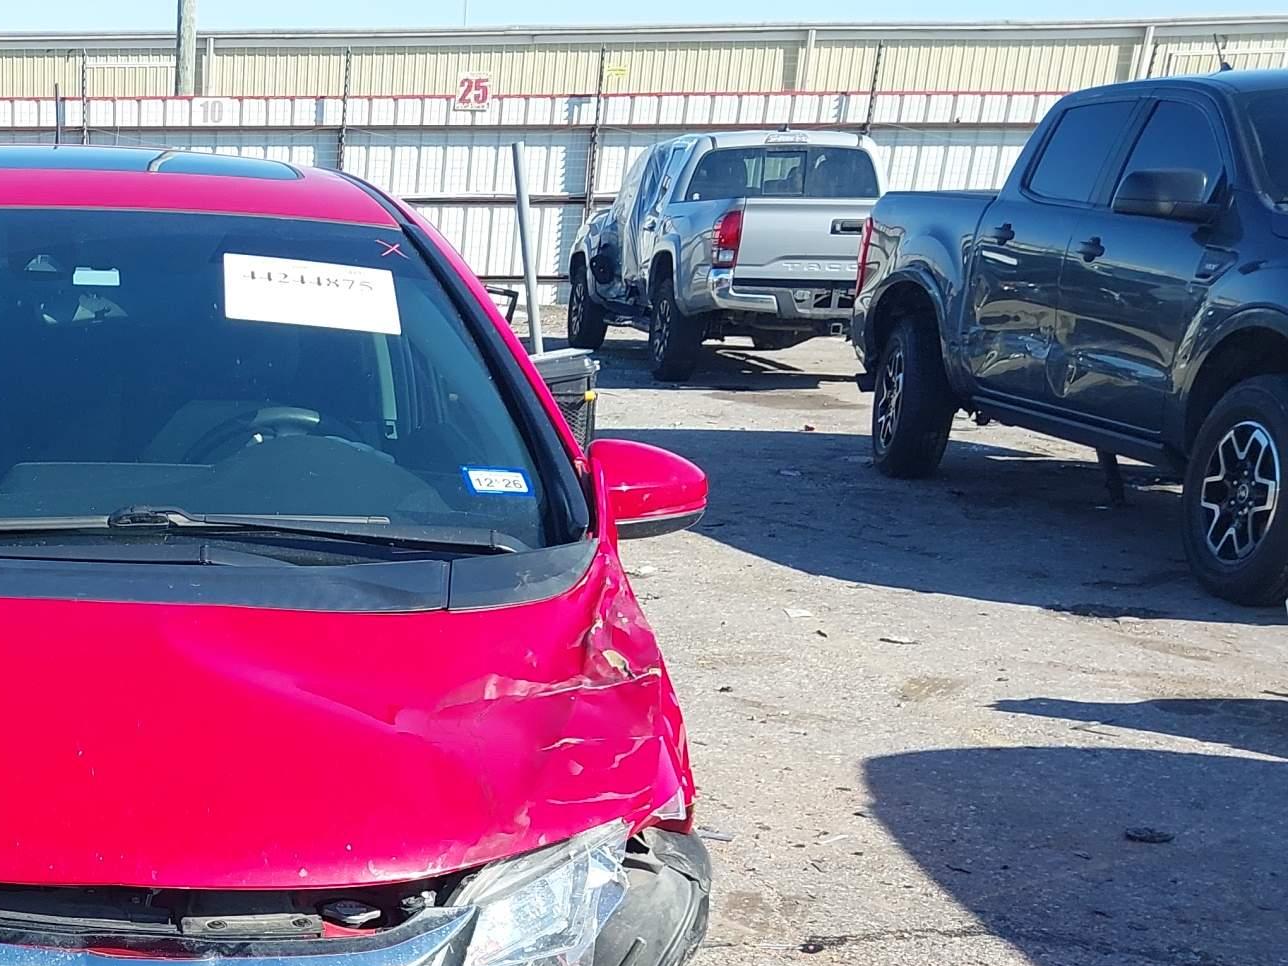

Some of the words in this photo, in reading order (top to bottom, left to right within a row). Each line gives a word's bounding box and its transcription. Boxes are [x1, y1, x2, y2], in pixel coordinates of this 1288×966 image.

[458, 78, 489, 104] 25
[199, 100, 224, 124] 10
[475, 477, 495, 488] 12
[502, 478, 523, 489] 26
